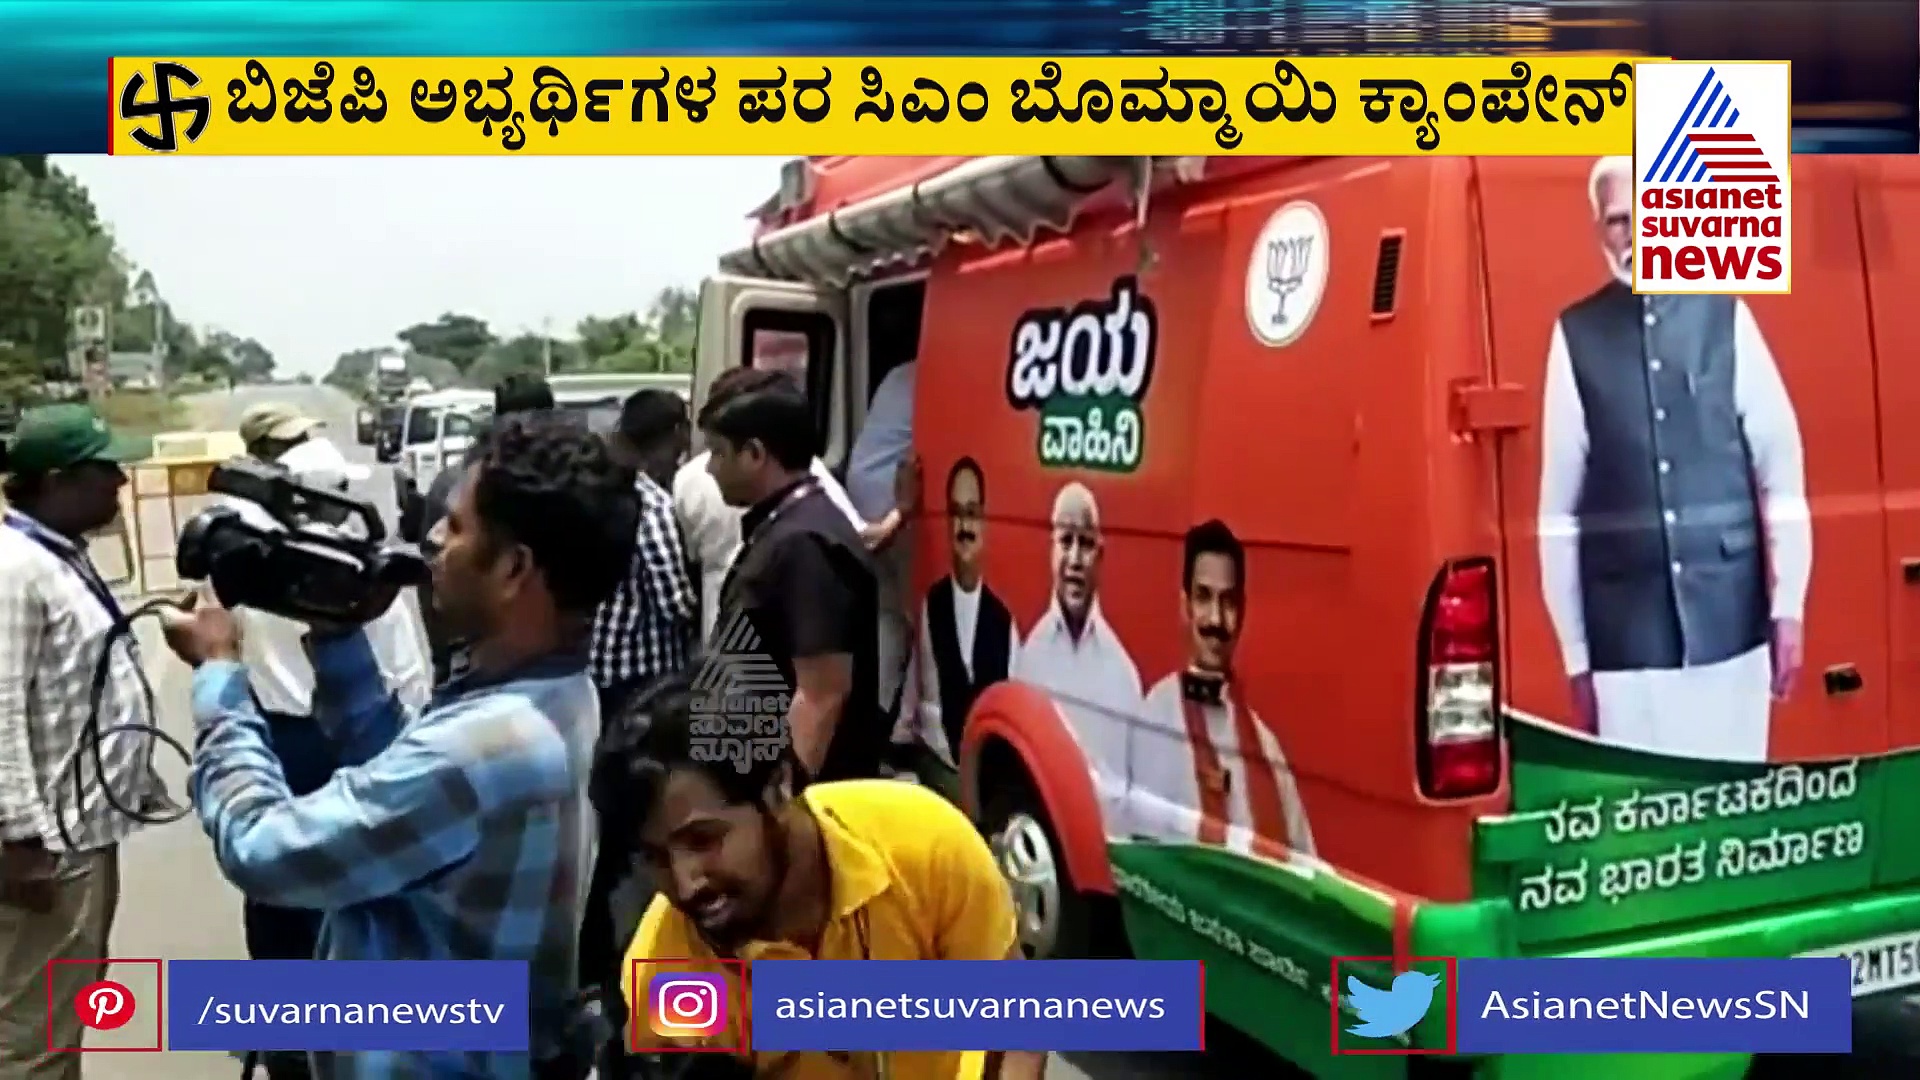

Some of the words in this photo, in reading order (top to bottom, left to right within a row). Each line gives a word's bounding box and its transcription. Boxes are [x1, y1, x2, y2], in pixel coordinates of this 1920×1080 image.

[1010, 286, 1152, 399] ಜಯ
[1041, 406, 1141, 466] ವಾಹಿನಿ
[1613, 756, 1861, 833] ಕರ್ನಾಟಕದಿಂದ
[1519, 857, 1589, 912] ನವ
[1600, 838, 1707, 905] ಭಾರತ
[1714, 820, 1864, 879] ನಿರ್ಮಾಣ
[1839, 939, 1920, 985] 2MT5
